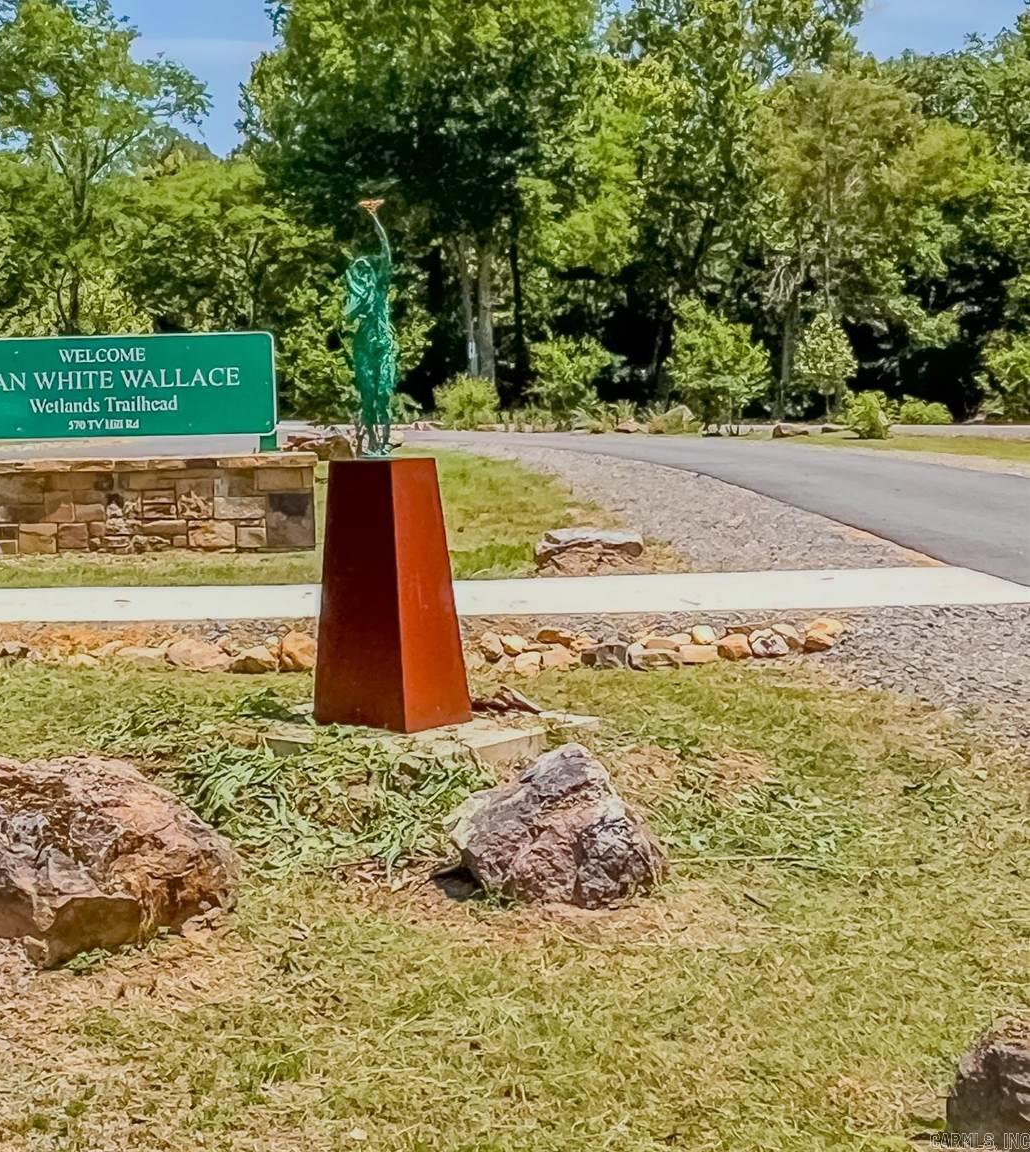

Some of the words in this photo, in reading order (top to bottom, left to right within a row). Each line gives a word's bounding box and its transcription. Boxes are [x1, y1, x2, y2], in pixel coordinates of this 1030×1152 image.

[59, 347, 146, 363] WELCOME
[33, 370, 114, 390] WHITE
[121, 367, 241, 388] WALLACE
[29, 397, 100, 413] Wetlands
[104, 395, 178, 412] Trailhead
[87, 418, 104, 430] TV
[125, 418, 139, 429] Rd
